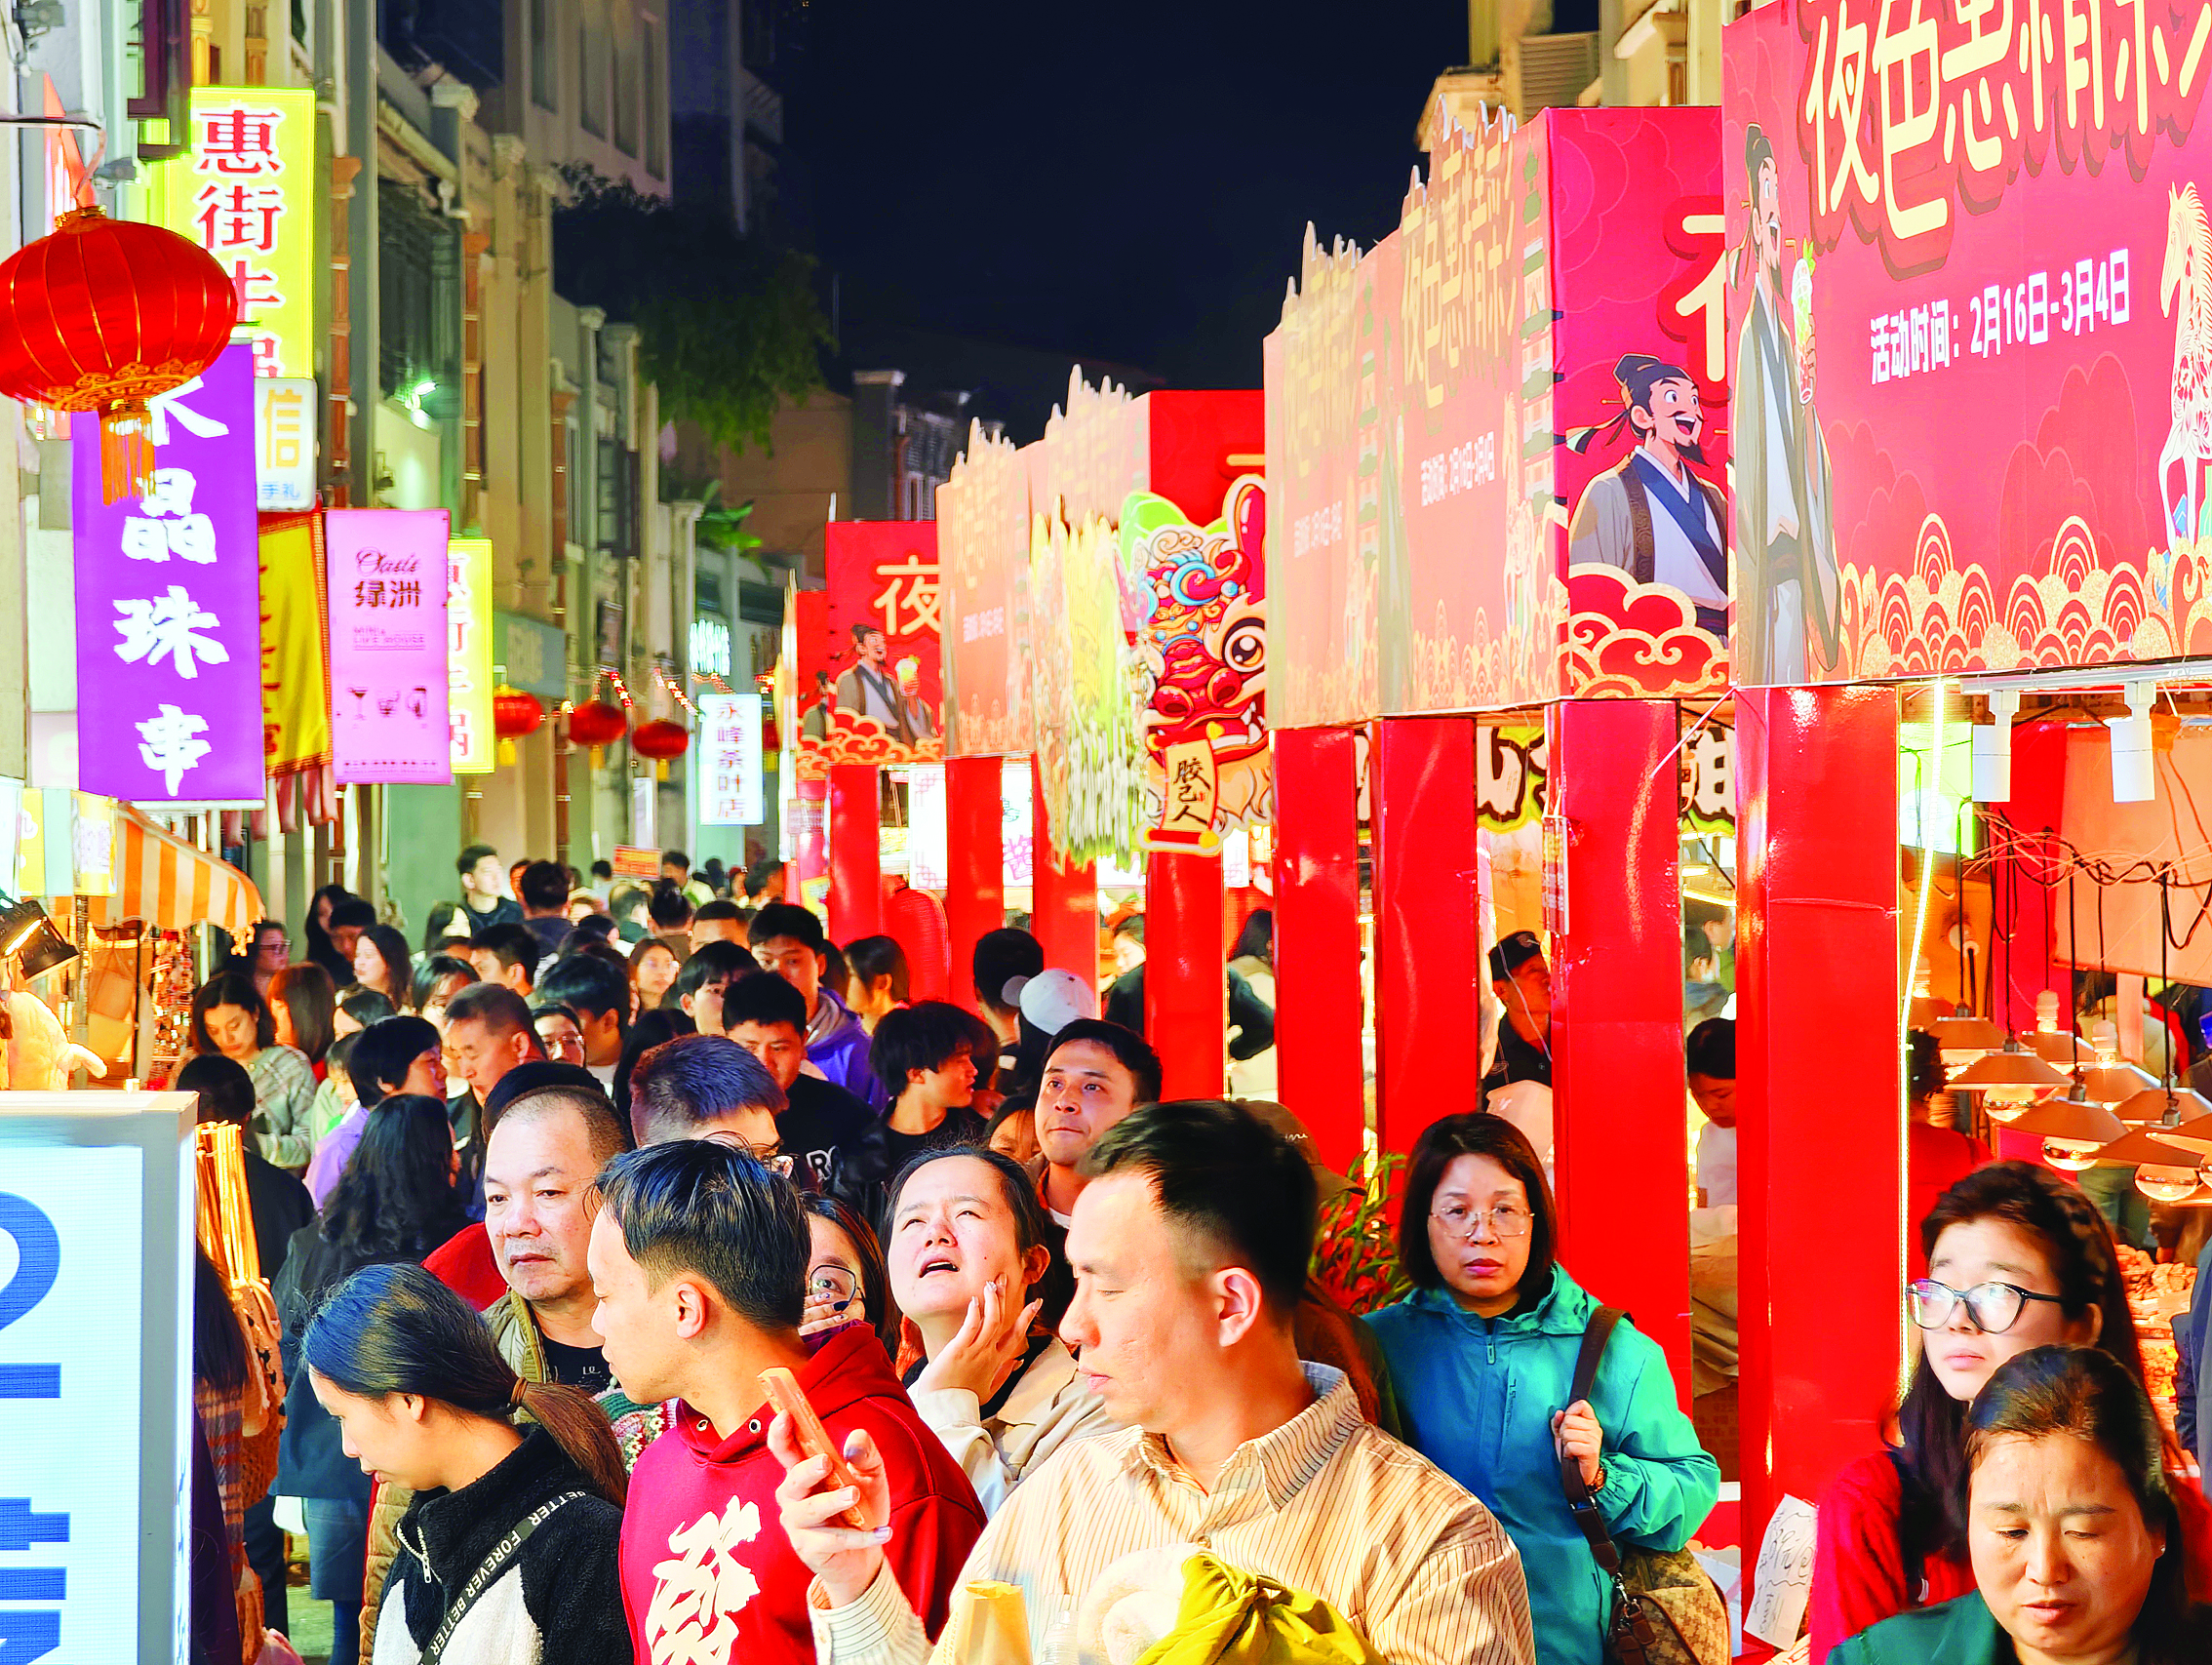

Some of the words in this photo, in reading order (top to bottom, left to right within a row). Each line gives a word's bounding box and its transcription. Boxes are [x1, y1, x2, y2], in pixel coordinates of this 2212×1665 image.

[354, 580, 422, 609] 绿洲
[717, 700, 745, 818] 永峰茶叶店
[1169, 756, 1211, 825] 胶己人
[528, 1491, 586, 1526] BETTER
[465, 1529, 522, 1598] FOREVER
[430, 1596, 467, 1656] BETTER
